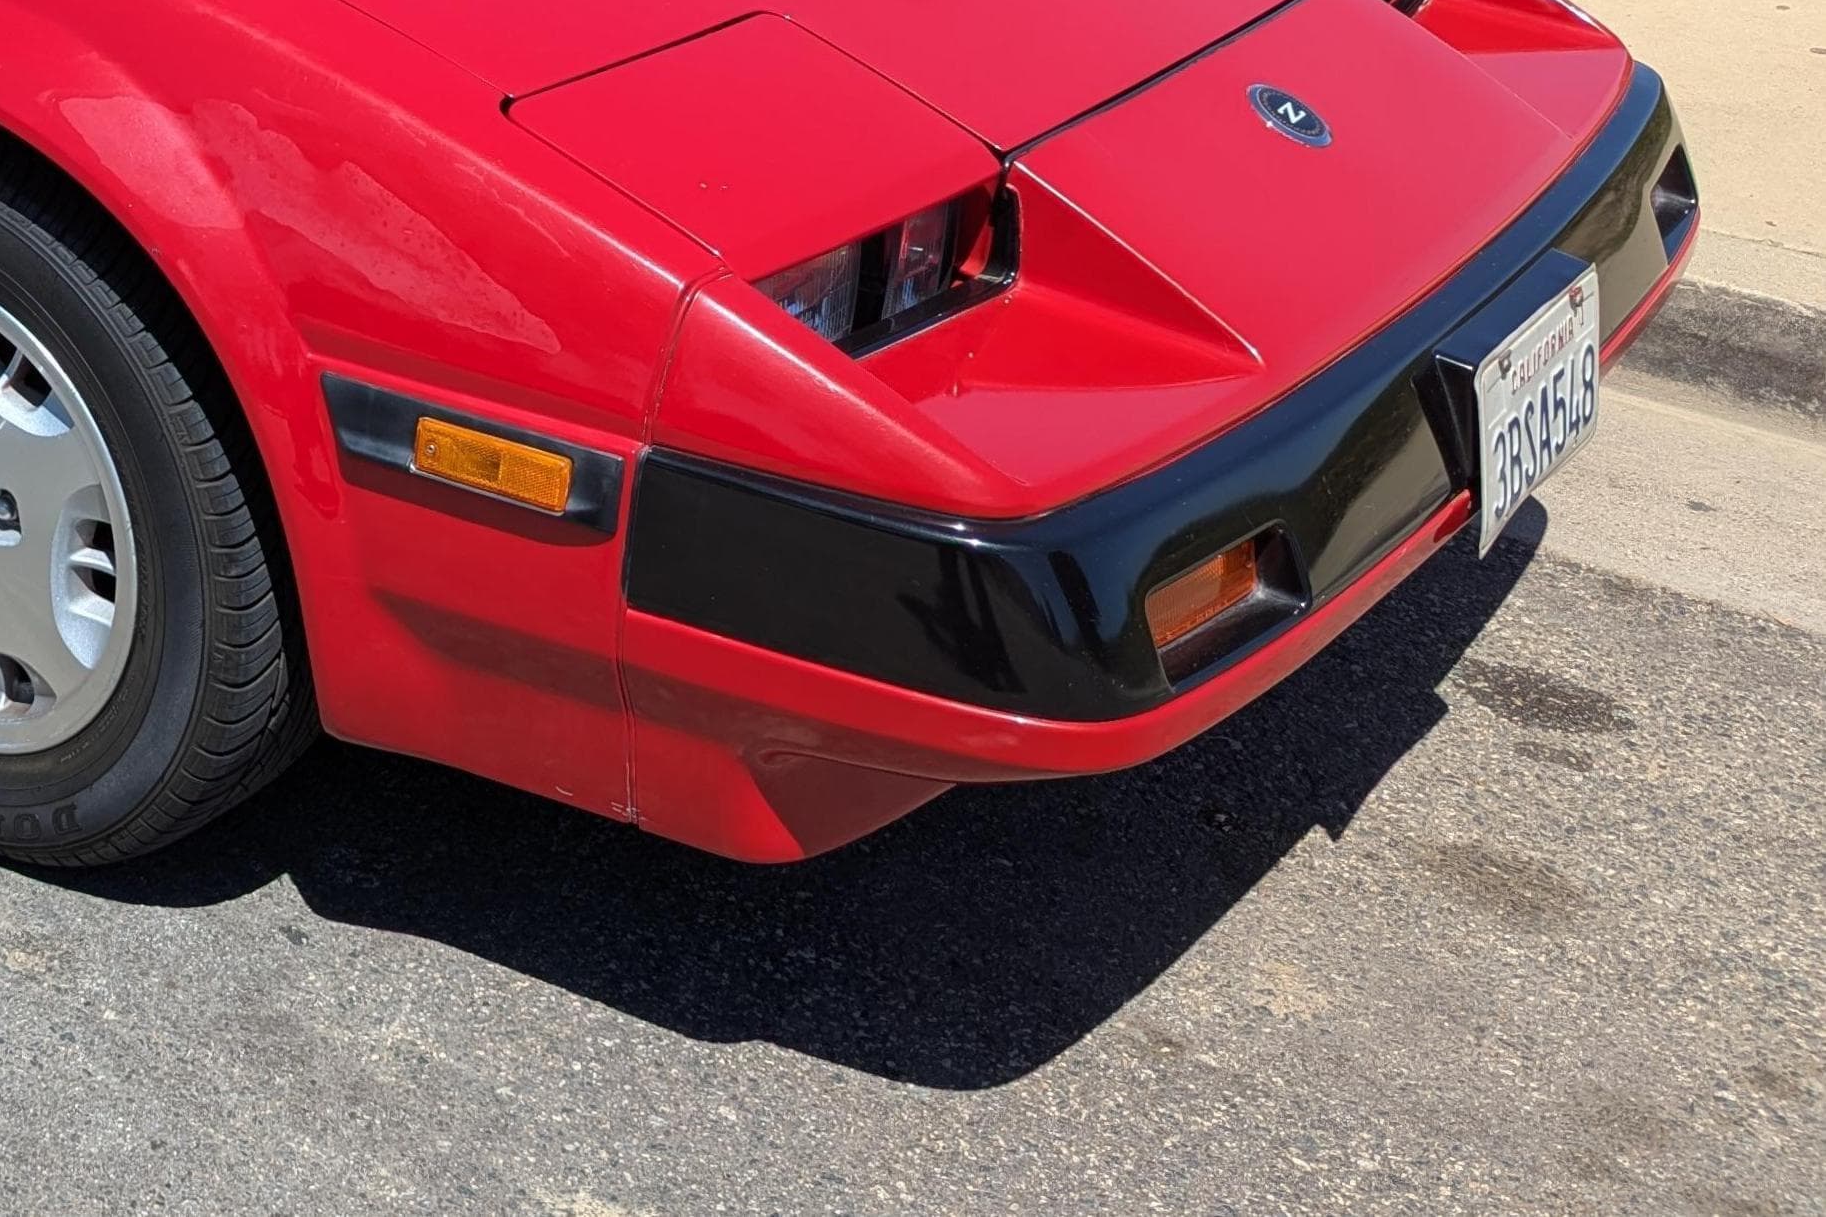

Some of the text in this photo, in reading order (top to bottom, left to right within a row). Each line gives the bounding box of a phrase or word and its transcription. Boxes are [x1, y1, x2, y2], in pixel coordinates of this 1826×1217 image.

[1277, 101, 1307, 124] Z
[1511, 315, 1574, 395] CALIFORNIA
[1493, 343, 1596, 520] 3BSA548
